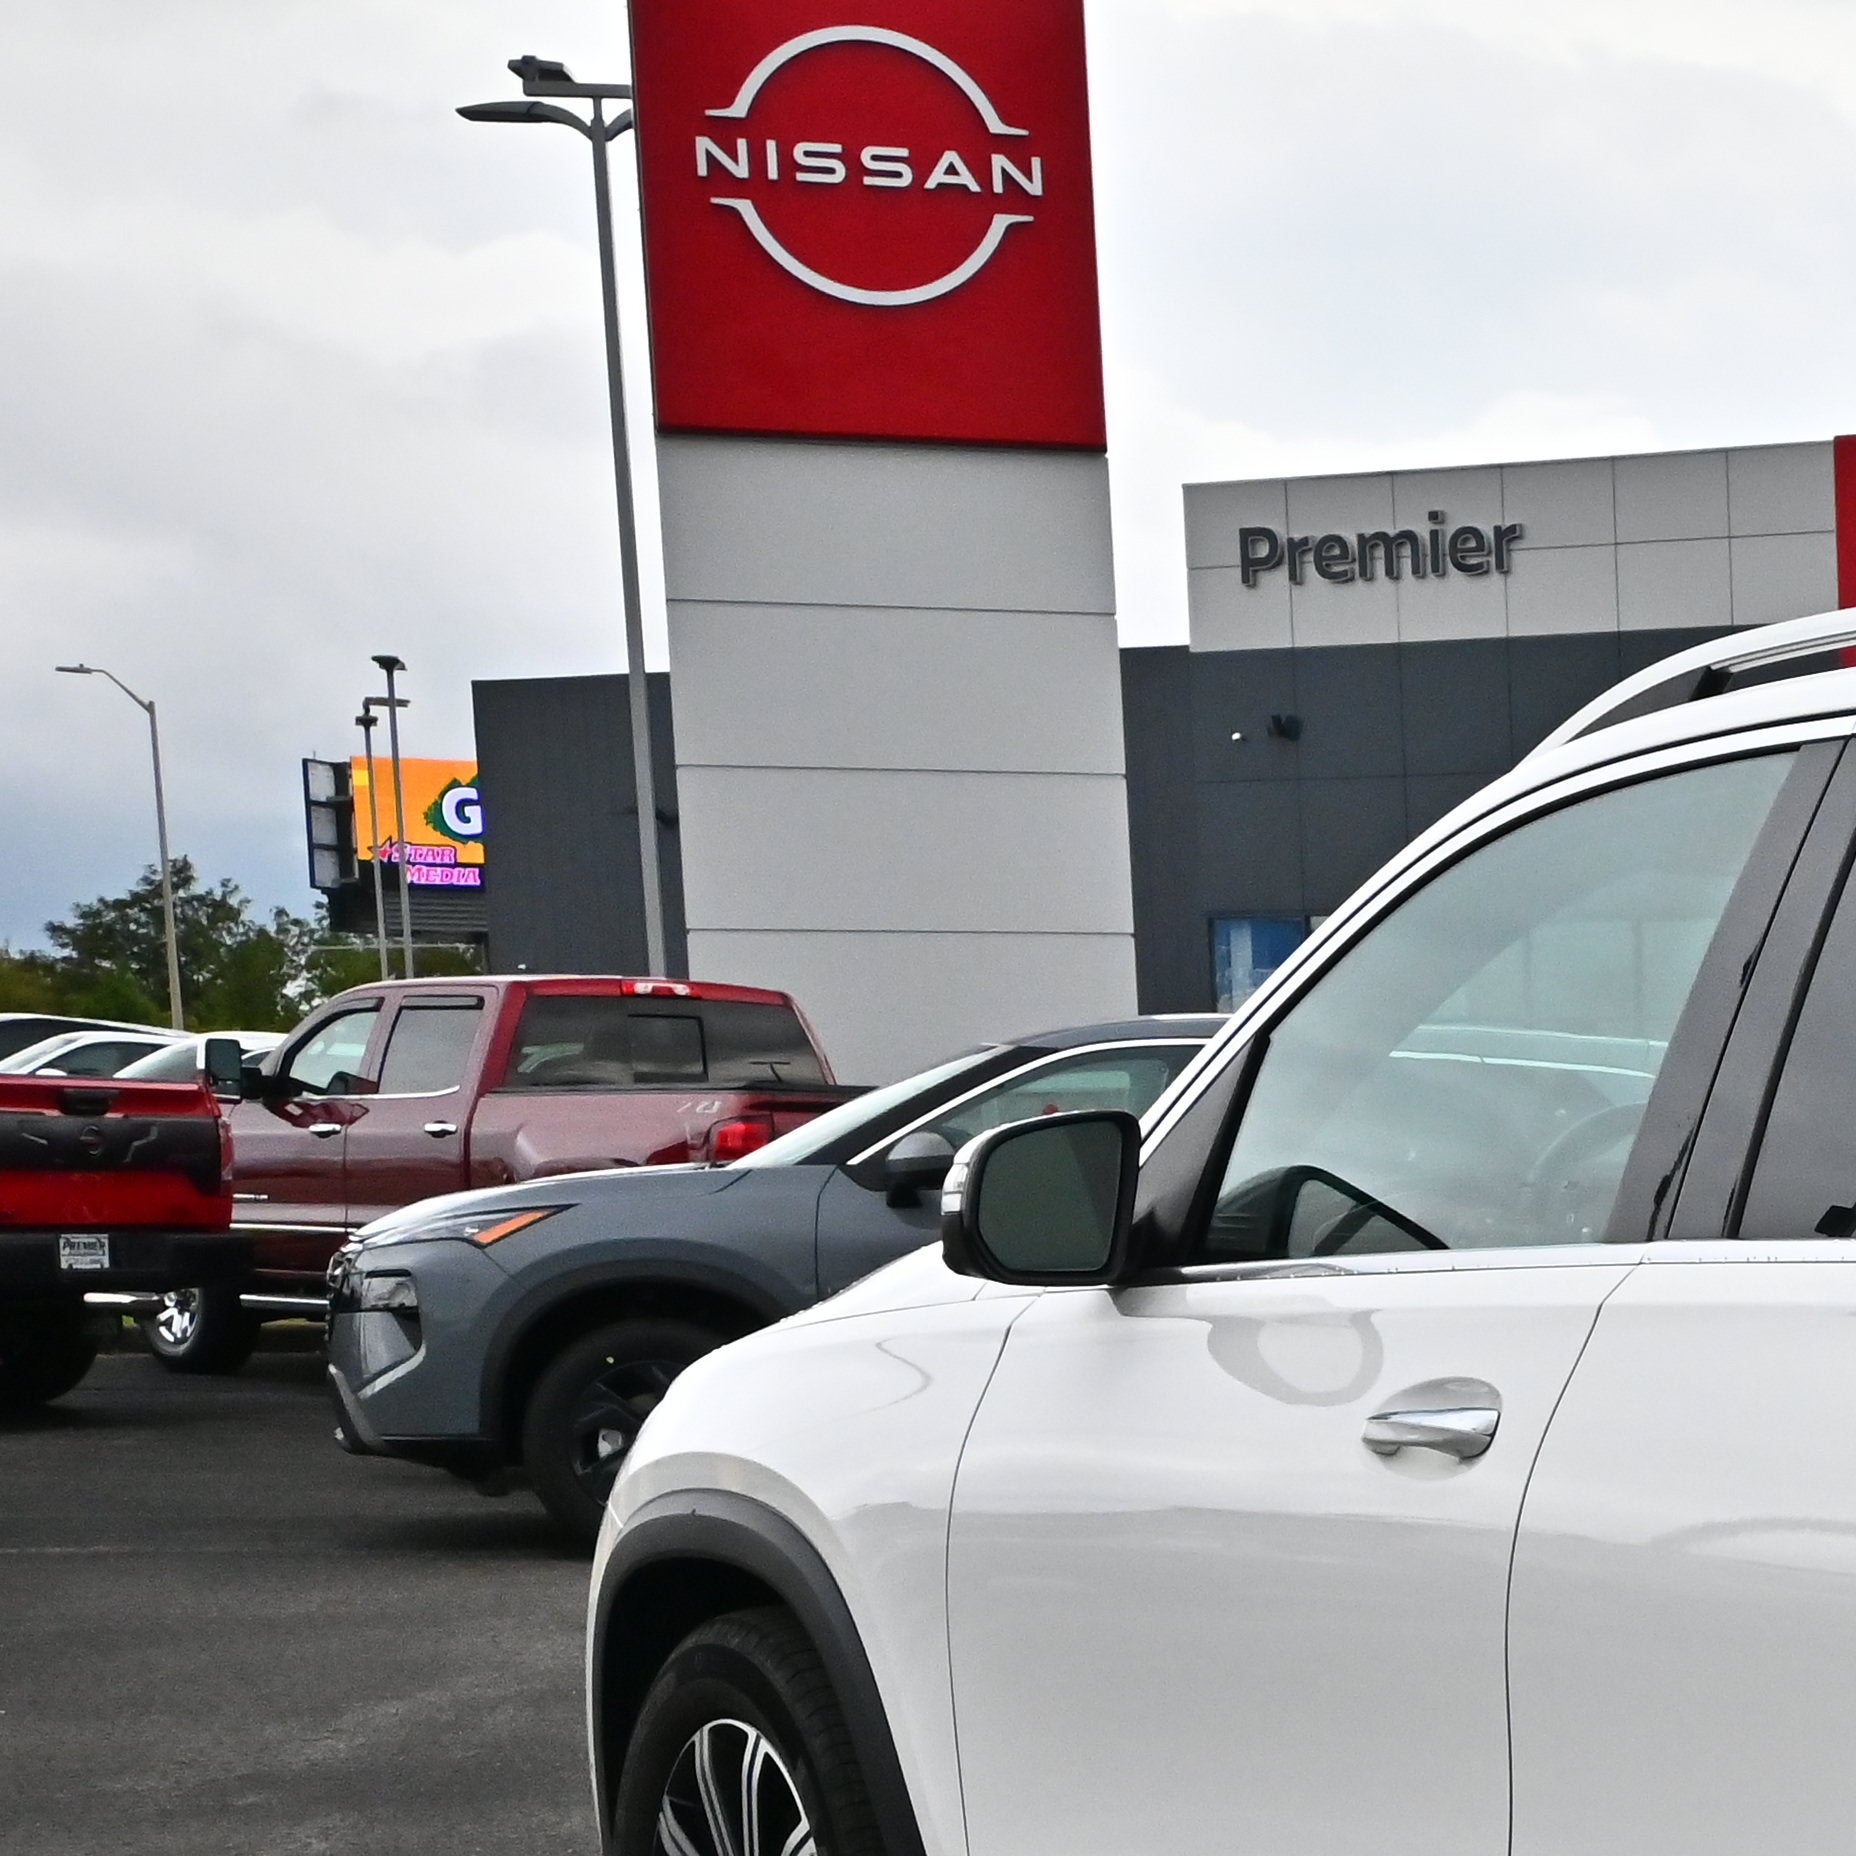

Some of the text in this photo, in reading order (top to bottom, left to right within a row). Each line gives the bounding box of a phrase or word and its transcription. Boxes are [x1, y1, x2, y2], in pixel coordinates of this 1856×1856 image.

[694, 135, 1043, 197] NISSAN
[1238, 510, 1523, 588] Premier
[405, 866, 481, 885] MEDIA
